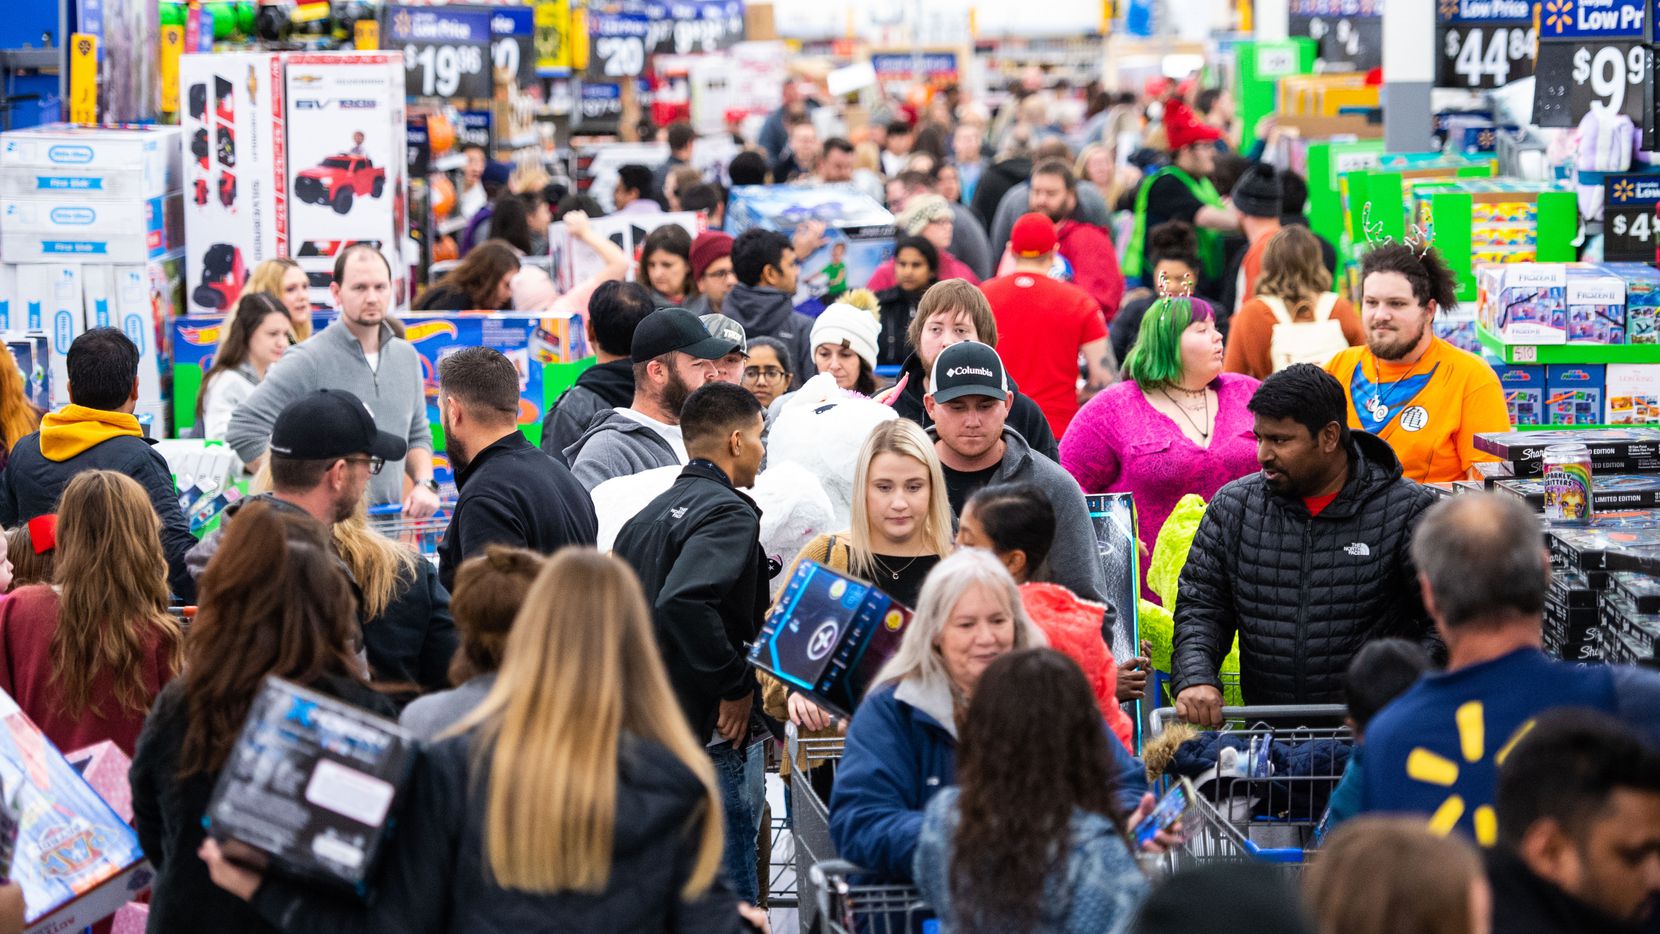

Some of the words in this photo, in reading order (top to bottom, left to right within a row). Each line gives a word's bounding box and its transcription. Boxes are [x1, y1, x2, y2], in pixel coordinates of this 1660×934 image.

[1460, 0, 1489, 18] Low
[1491, 0, 1528, 18] Price
[1577, 7, 1619, 30] Low
[1621, 5, 1645, 29] Pr
[954, 365, 993, 378] Columbia
[1594, 447, 1616, 455] EDITION
